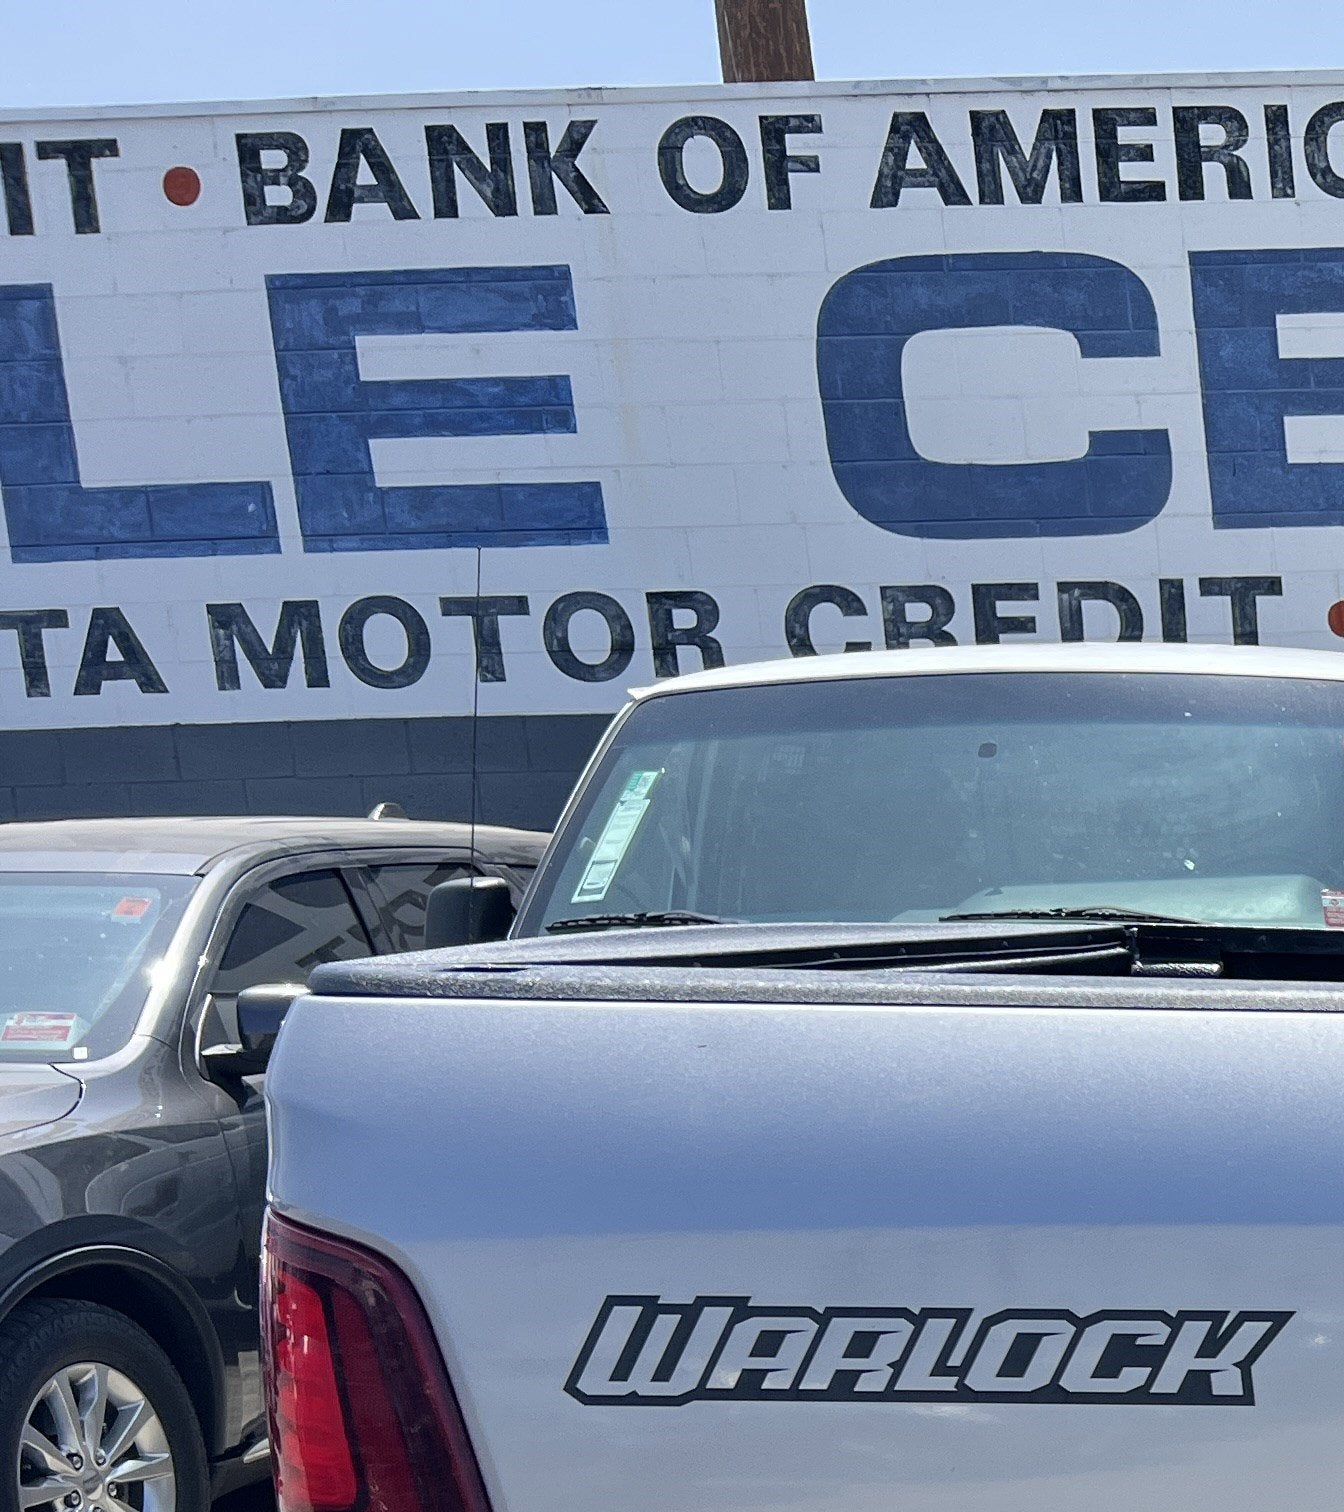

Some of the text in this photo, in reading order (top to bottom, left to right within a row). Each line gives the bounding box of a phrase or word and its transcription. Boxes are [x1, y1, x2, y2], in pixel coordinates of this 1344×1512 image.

[235, 119, 609, 227] BANK
[657, 114, 823, 213] OF
[0, 264, 609, 564] LE
[0, 606, 170, 698] TA
[206, 591, 726, 692] MOTOR
[563, 1295, 1296, 1406] WARLOCK
